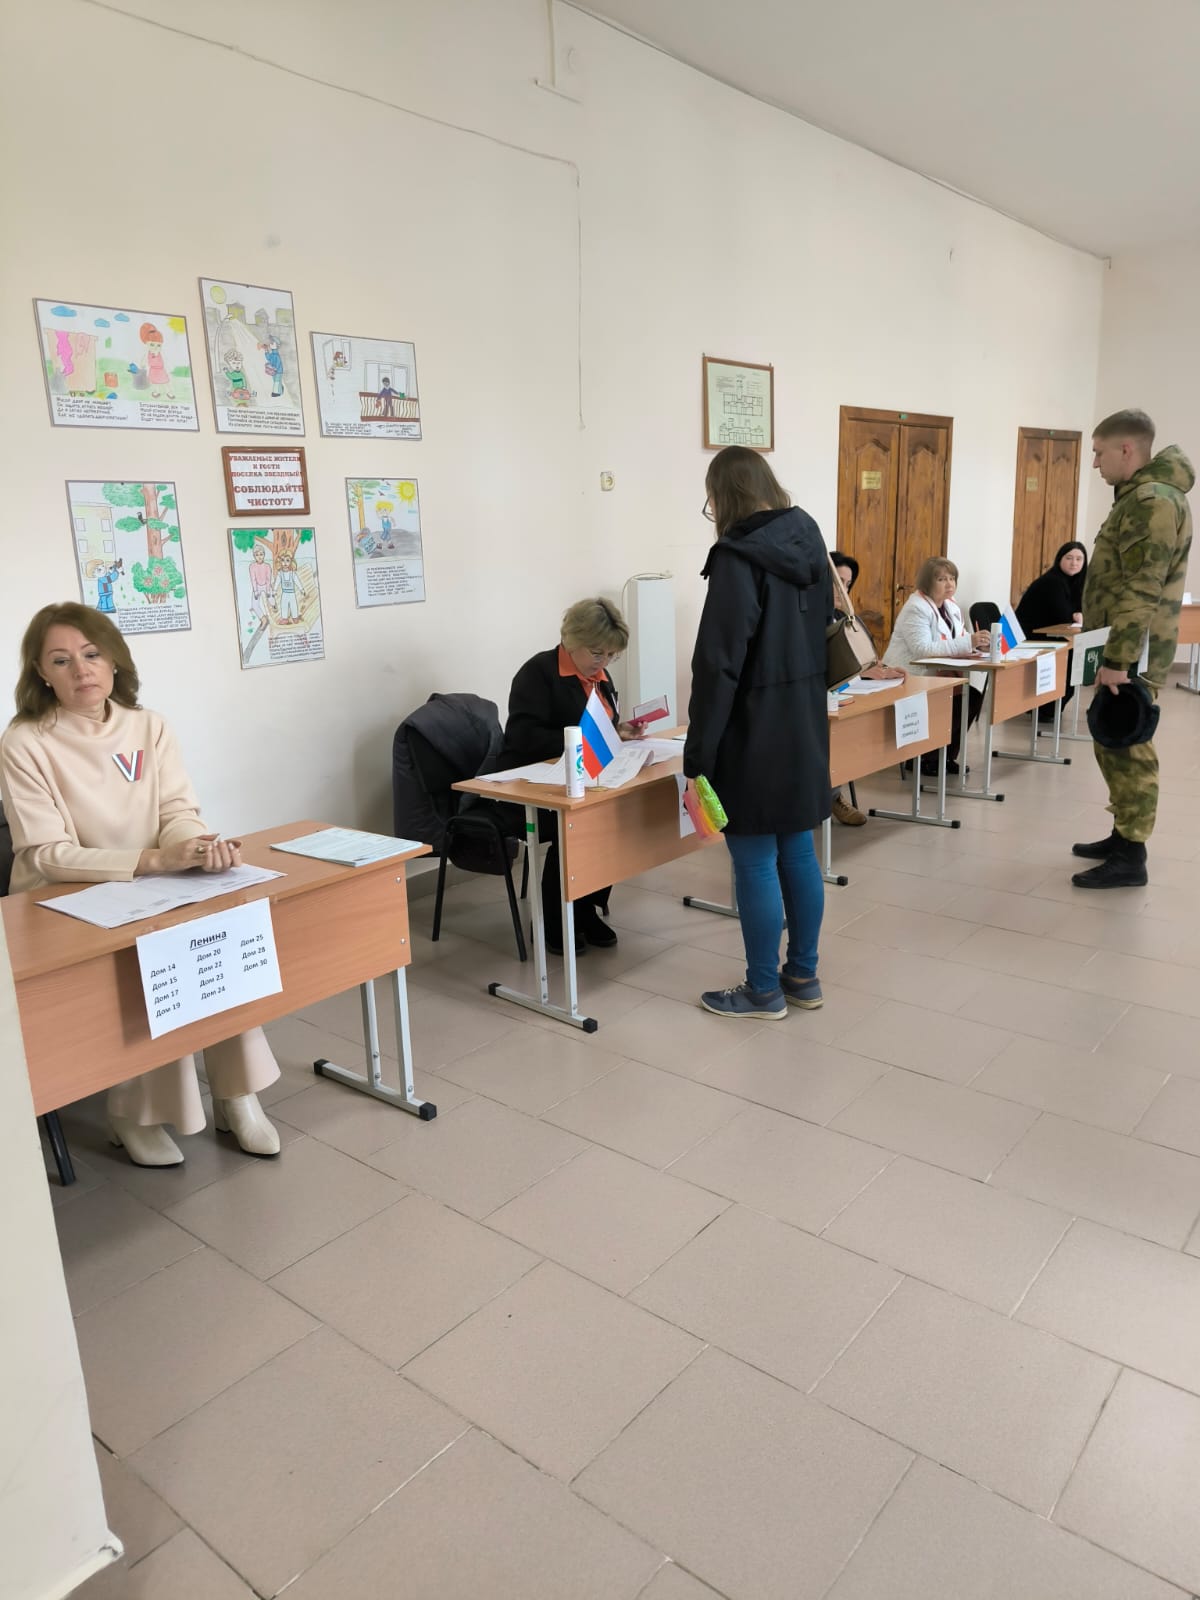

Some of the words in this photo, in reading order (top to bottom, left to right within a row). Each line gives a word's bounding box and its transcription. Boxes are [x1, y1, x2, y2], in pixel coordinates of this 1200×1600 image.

[234, 484, 304, 494] СОБЛЮДАЙТЕ
[248, 498, 294, 506] ЧИСТОТУ
[190, 931, 227, 949] Ленина
[240, 938, 254, 947] Дом
[256, 934, 264, 942] 25
[196, 952, 212, 962] Дом
[242, 951, 256, 960] Дом
[150, 968, 166, 978] Дом
[168, 964, 176, 972] 14
[198, 965, 213, 974] Дом
[244, 963, 258, 972] Дом
[152, 982, 168, 991] Дом
[200, 978, 214, 988] Дом
[216, 974, 224, 982] 23
[154, 994, 170, 1004] Дом
[170, 990, 179, 998] 17
[201, 990, 216, 1000] Дом
[217, 986, 226, 994] 24
[156, 1008, 171, 1018] Дом
[172, 1002, 180, 1011] 19
